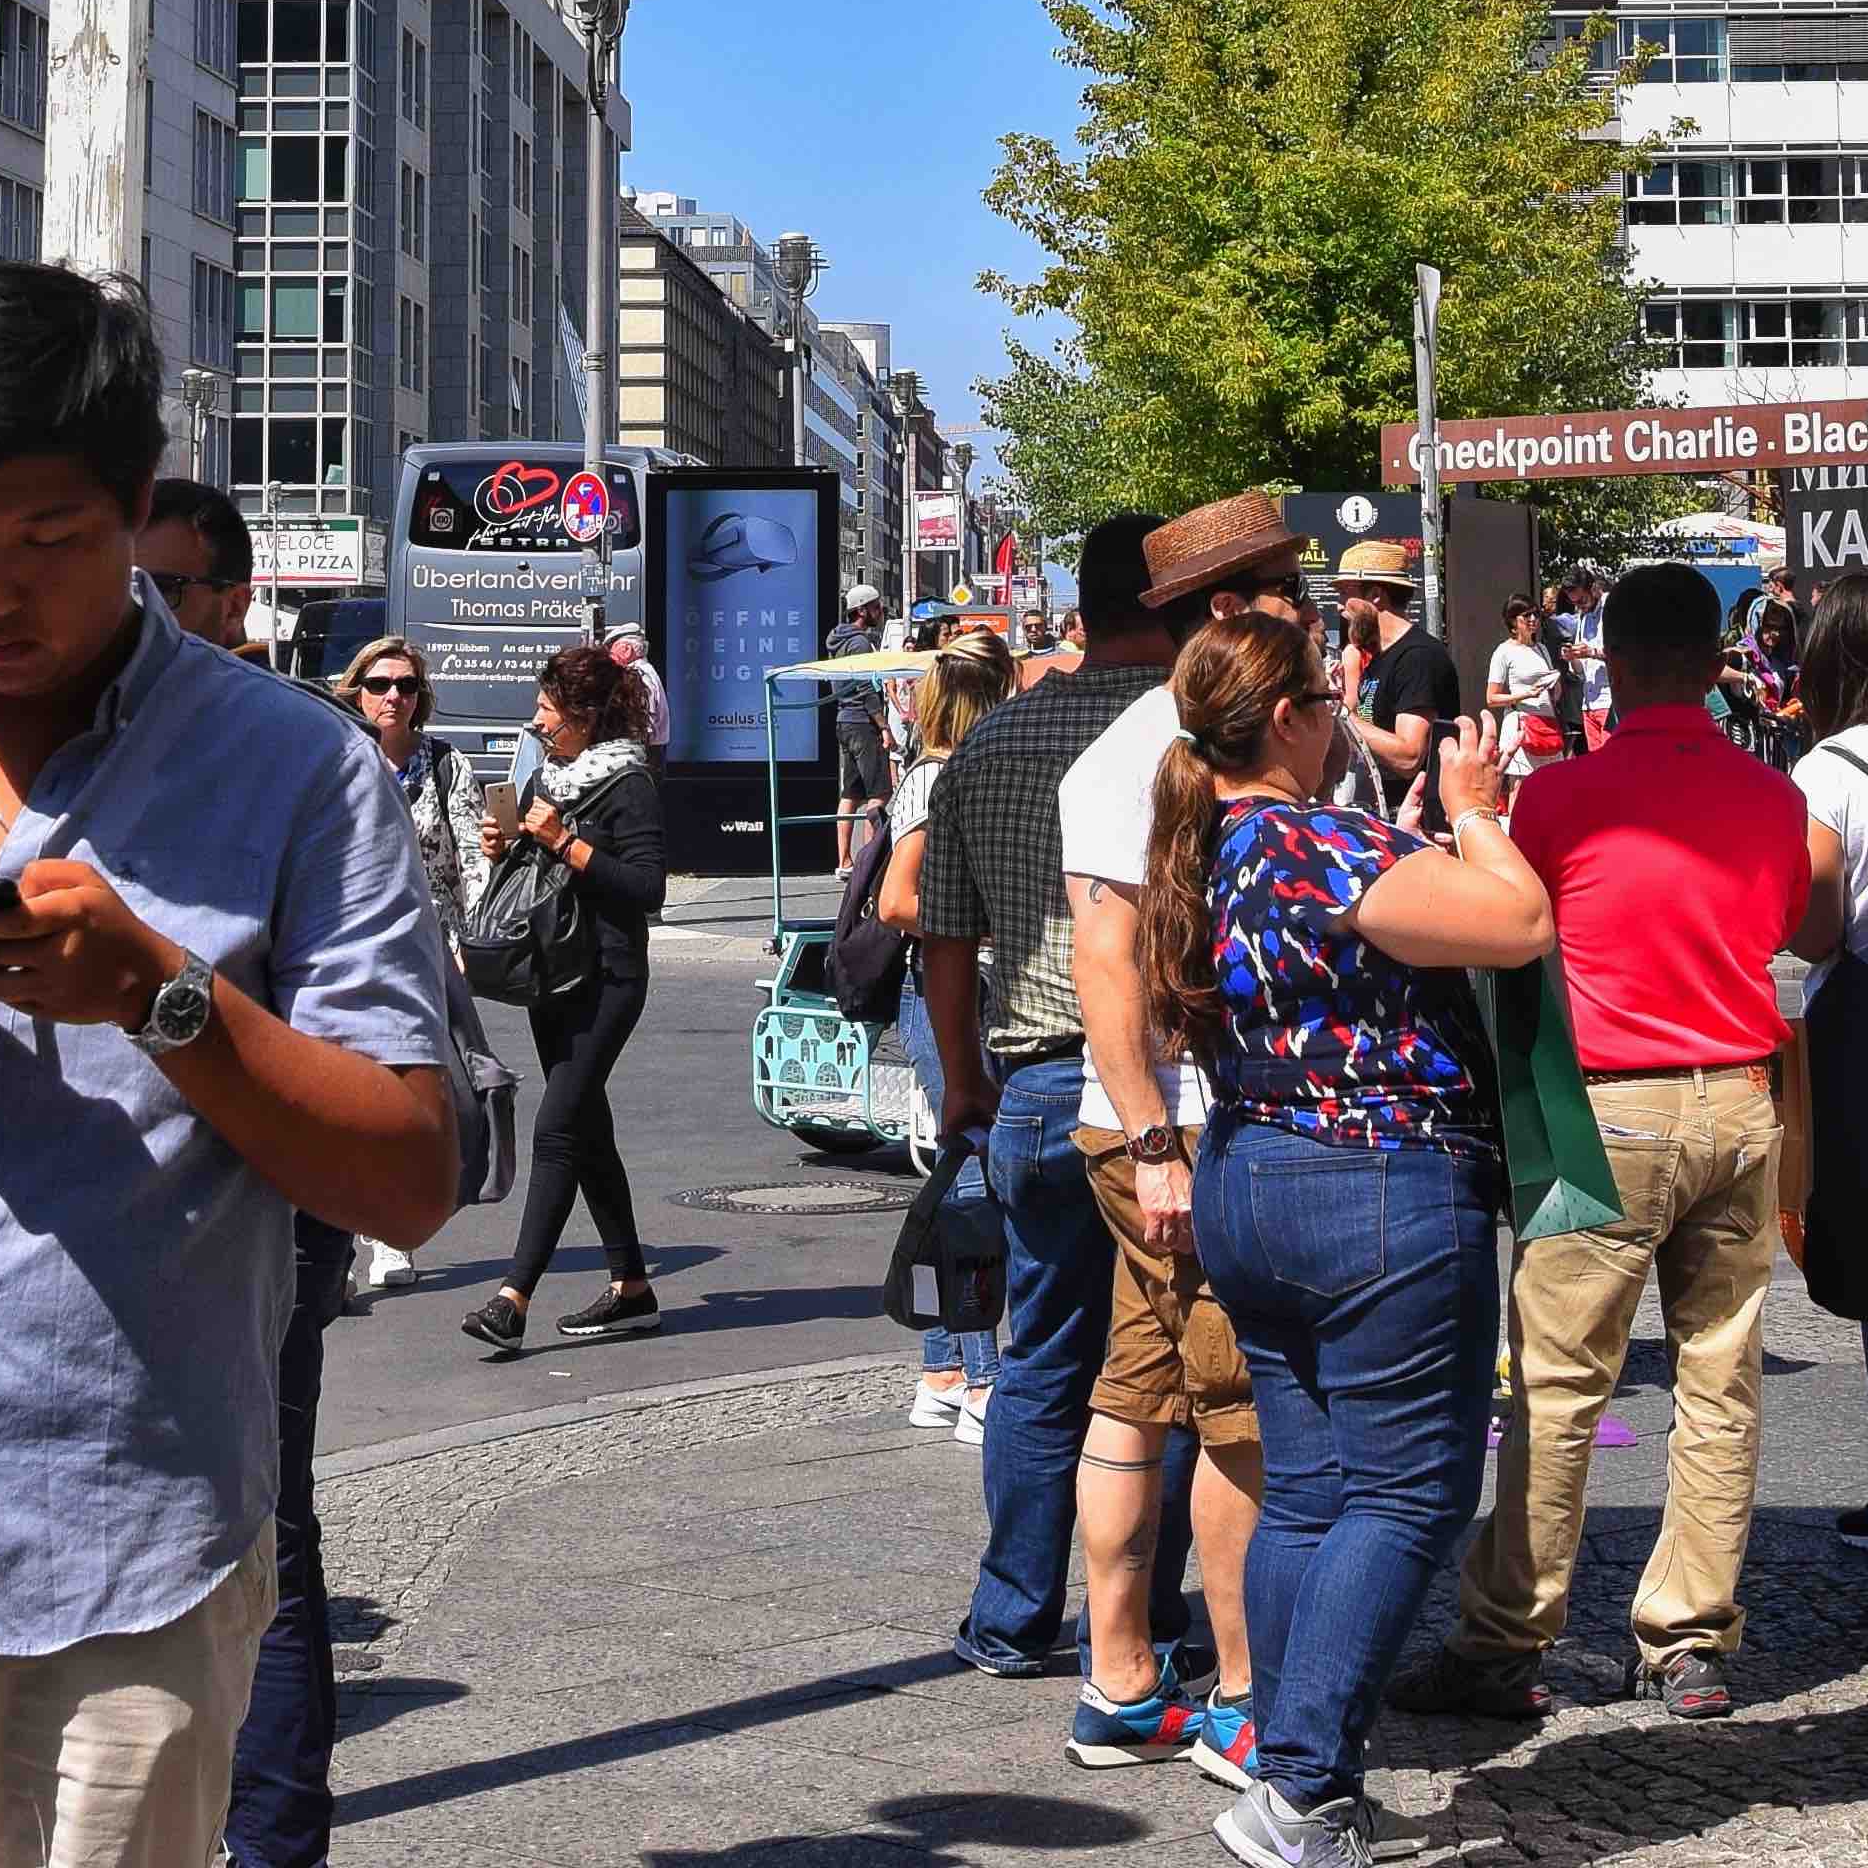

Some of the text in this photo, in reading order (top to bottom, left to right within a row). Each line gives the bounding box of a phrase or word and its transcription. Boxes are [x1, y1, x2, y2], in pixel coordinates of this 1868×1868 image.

[1624, 416, 1758, 462] Charlie
[480, 536, 569, 547] SETRA
[298, 555, 354, 570] PIZZA
[412, 564, 636, 591] Überlandverhr
[451, 598, 526, 618] Thomas
[685, 637, 800, 653] DEINE
[708, 711, 755, 725] oculus
